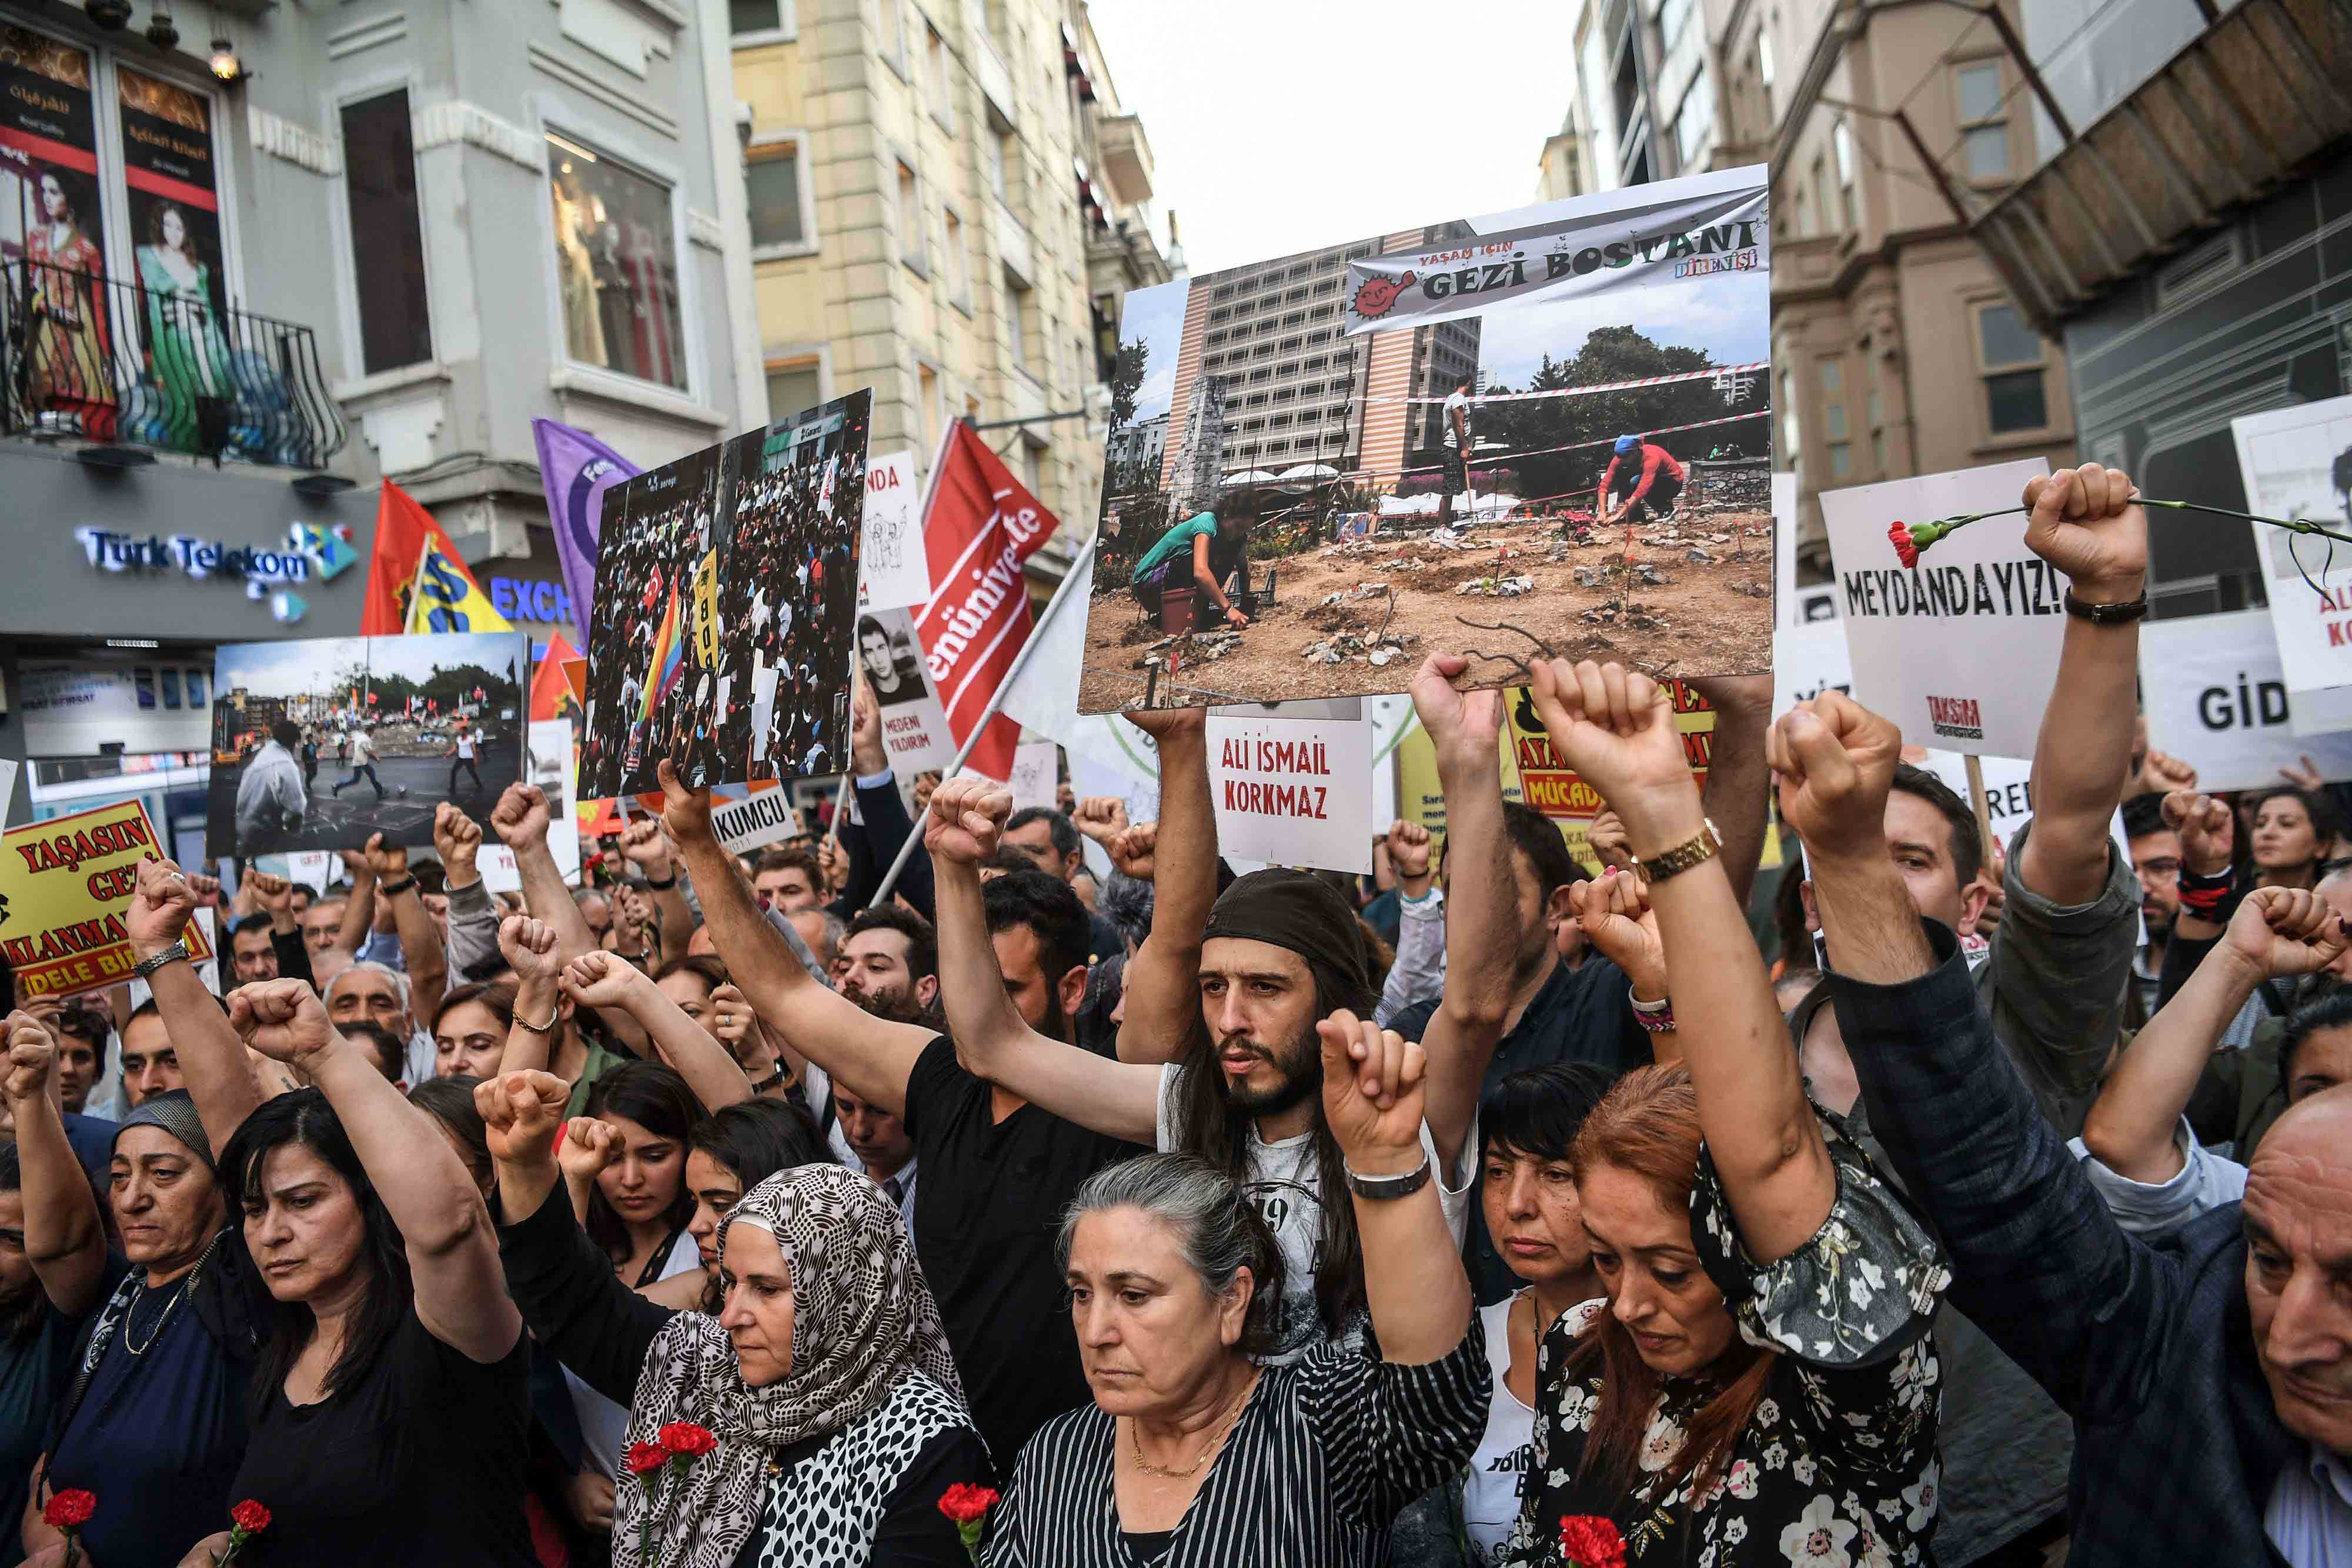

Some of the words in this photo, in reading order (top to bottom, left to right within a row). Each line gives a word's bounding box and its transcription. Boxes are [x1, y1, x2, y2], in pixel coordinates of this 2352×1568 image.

[1421, 251, 1529, 300] GEZİ
[1542, 220, 1759, 282] BOSTANI
[88, 530, 170, 569] Türk
[175, 536, 309, 578] Telekom
[1843, 559, 2062, 617] MEYDANDAYIZ!
[1221, 731, 1249, 771] ALİ
[1257, 732, 1331, 775] İSMAİL
[711, 794, 786, 843] KUMCU
[1224, 780, 1327, 820] KORKMAZ
[16, 817, 151, 874] YAŞASIN
